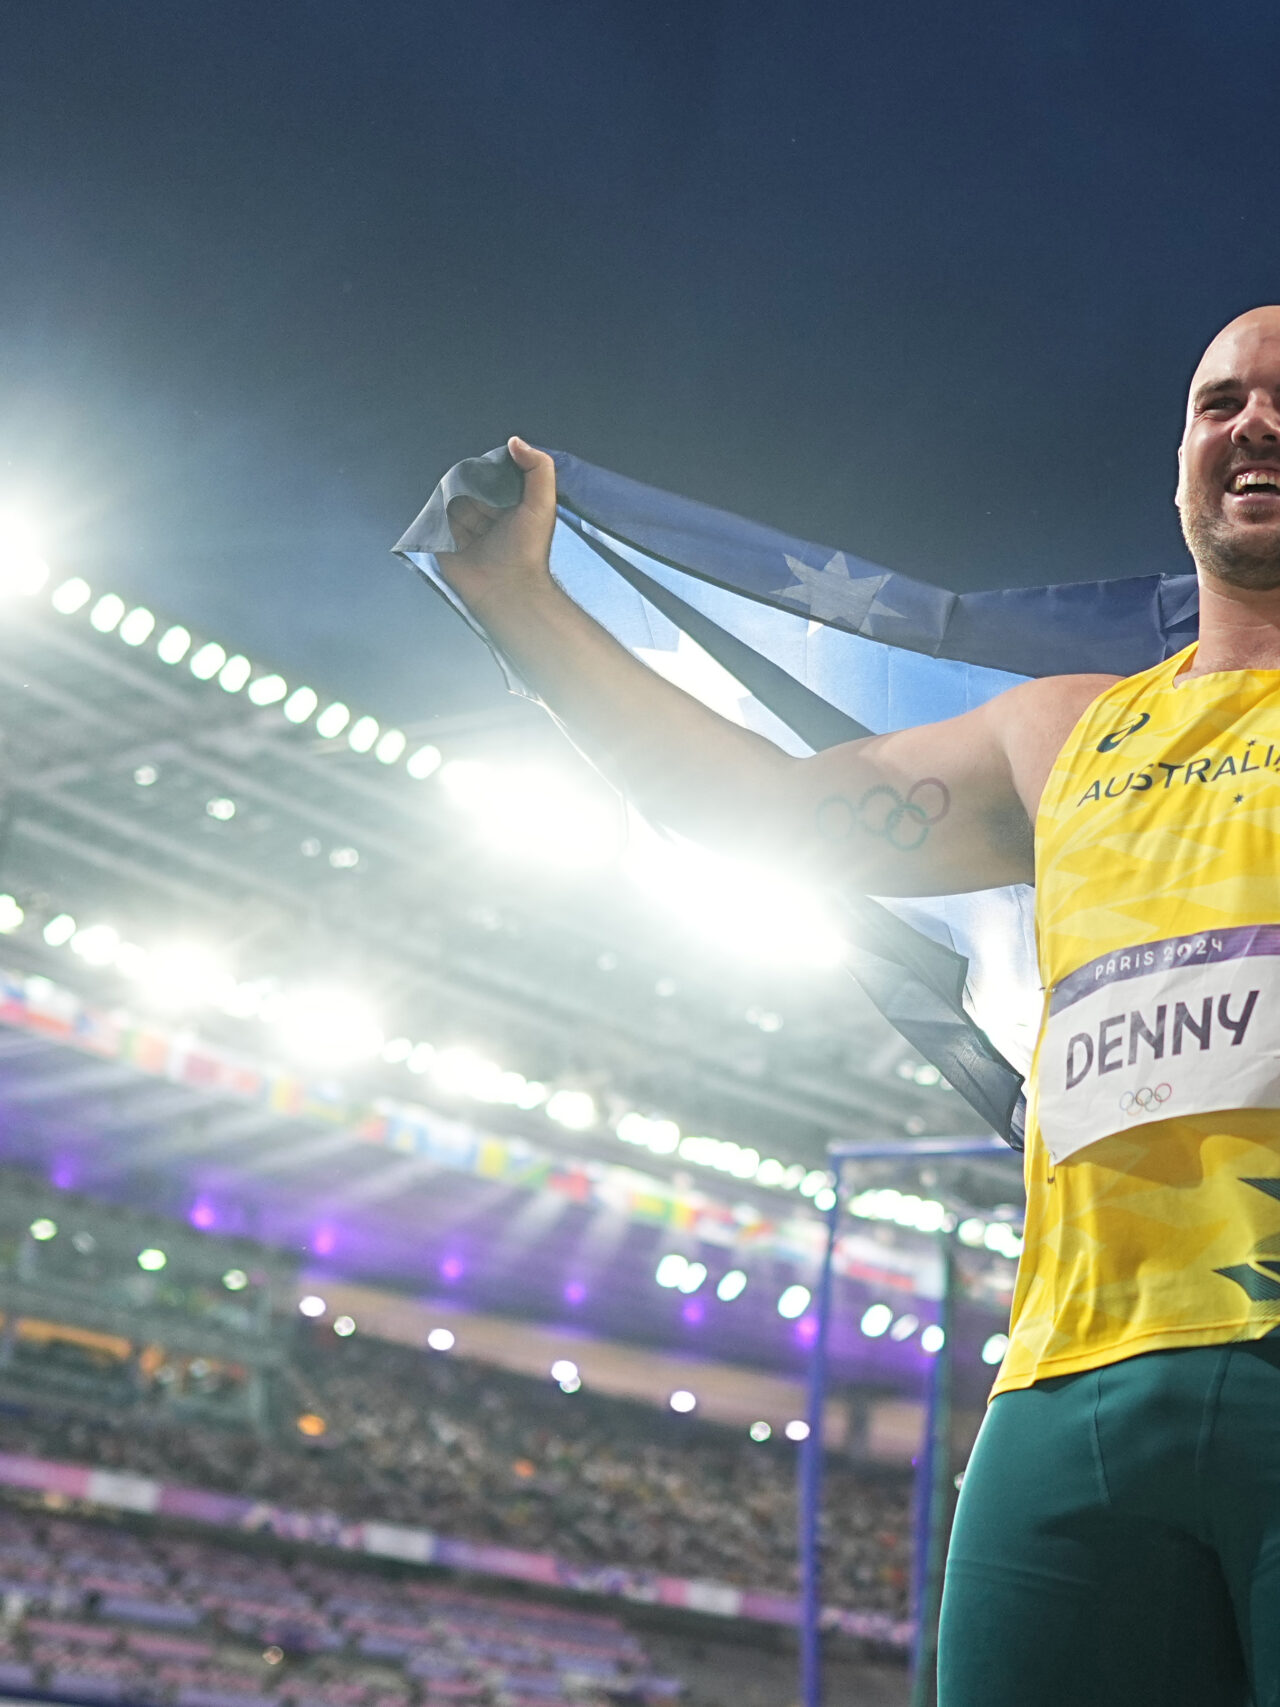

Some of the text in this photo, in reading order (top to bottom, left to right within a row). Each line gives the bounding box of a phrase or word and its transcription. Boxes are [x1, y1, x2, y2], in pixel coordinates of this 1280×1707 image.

[1095, 938, 1223, 980] PARIS 2024
[1065, 990, 1260, 1090] DENNY
